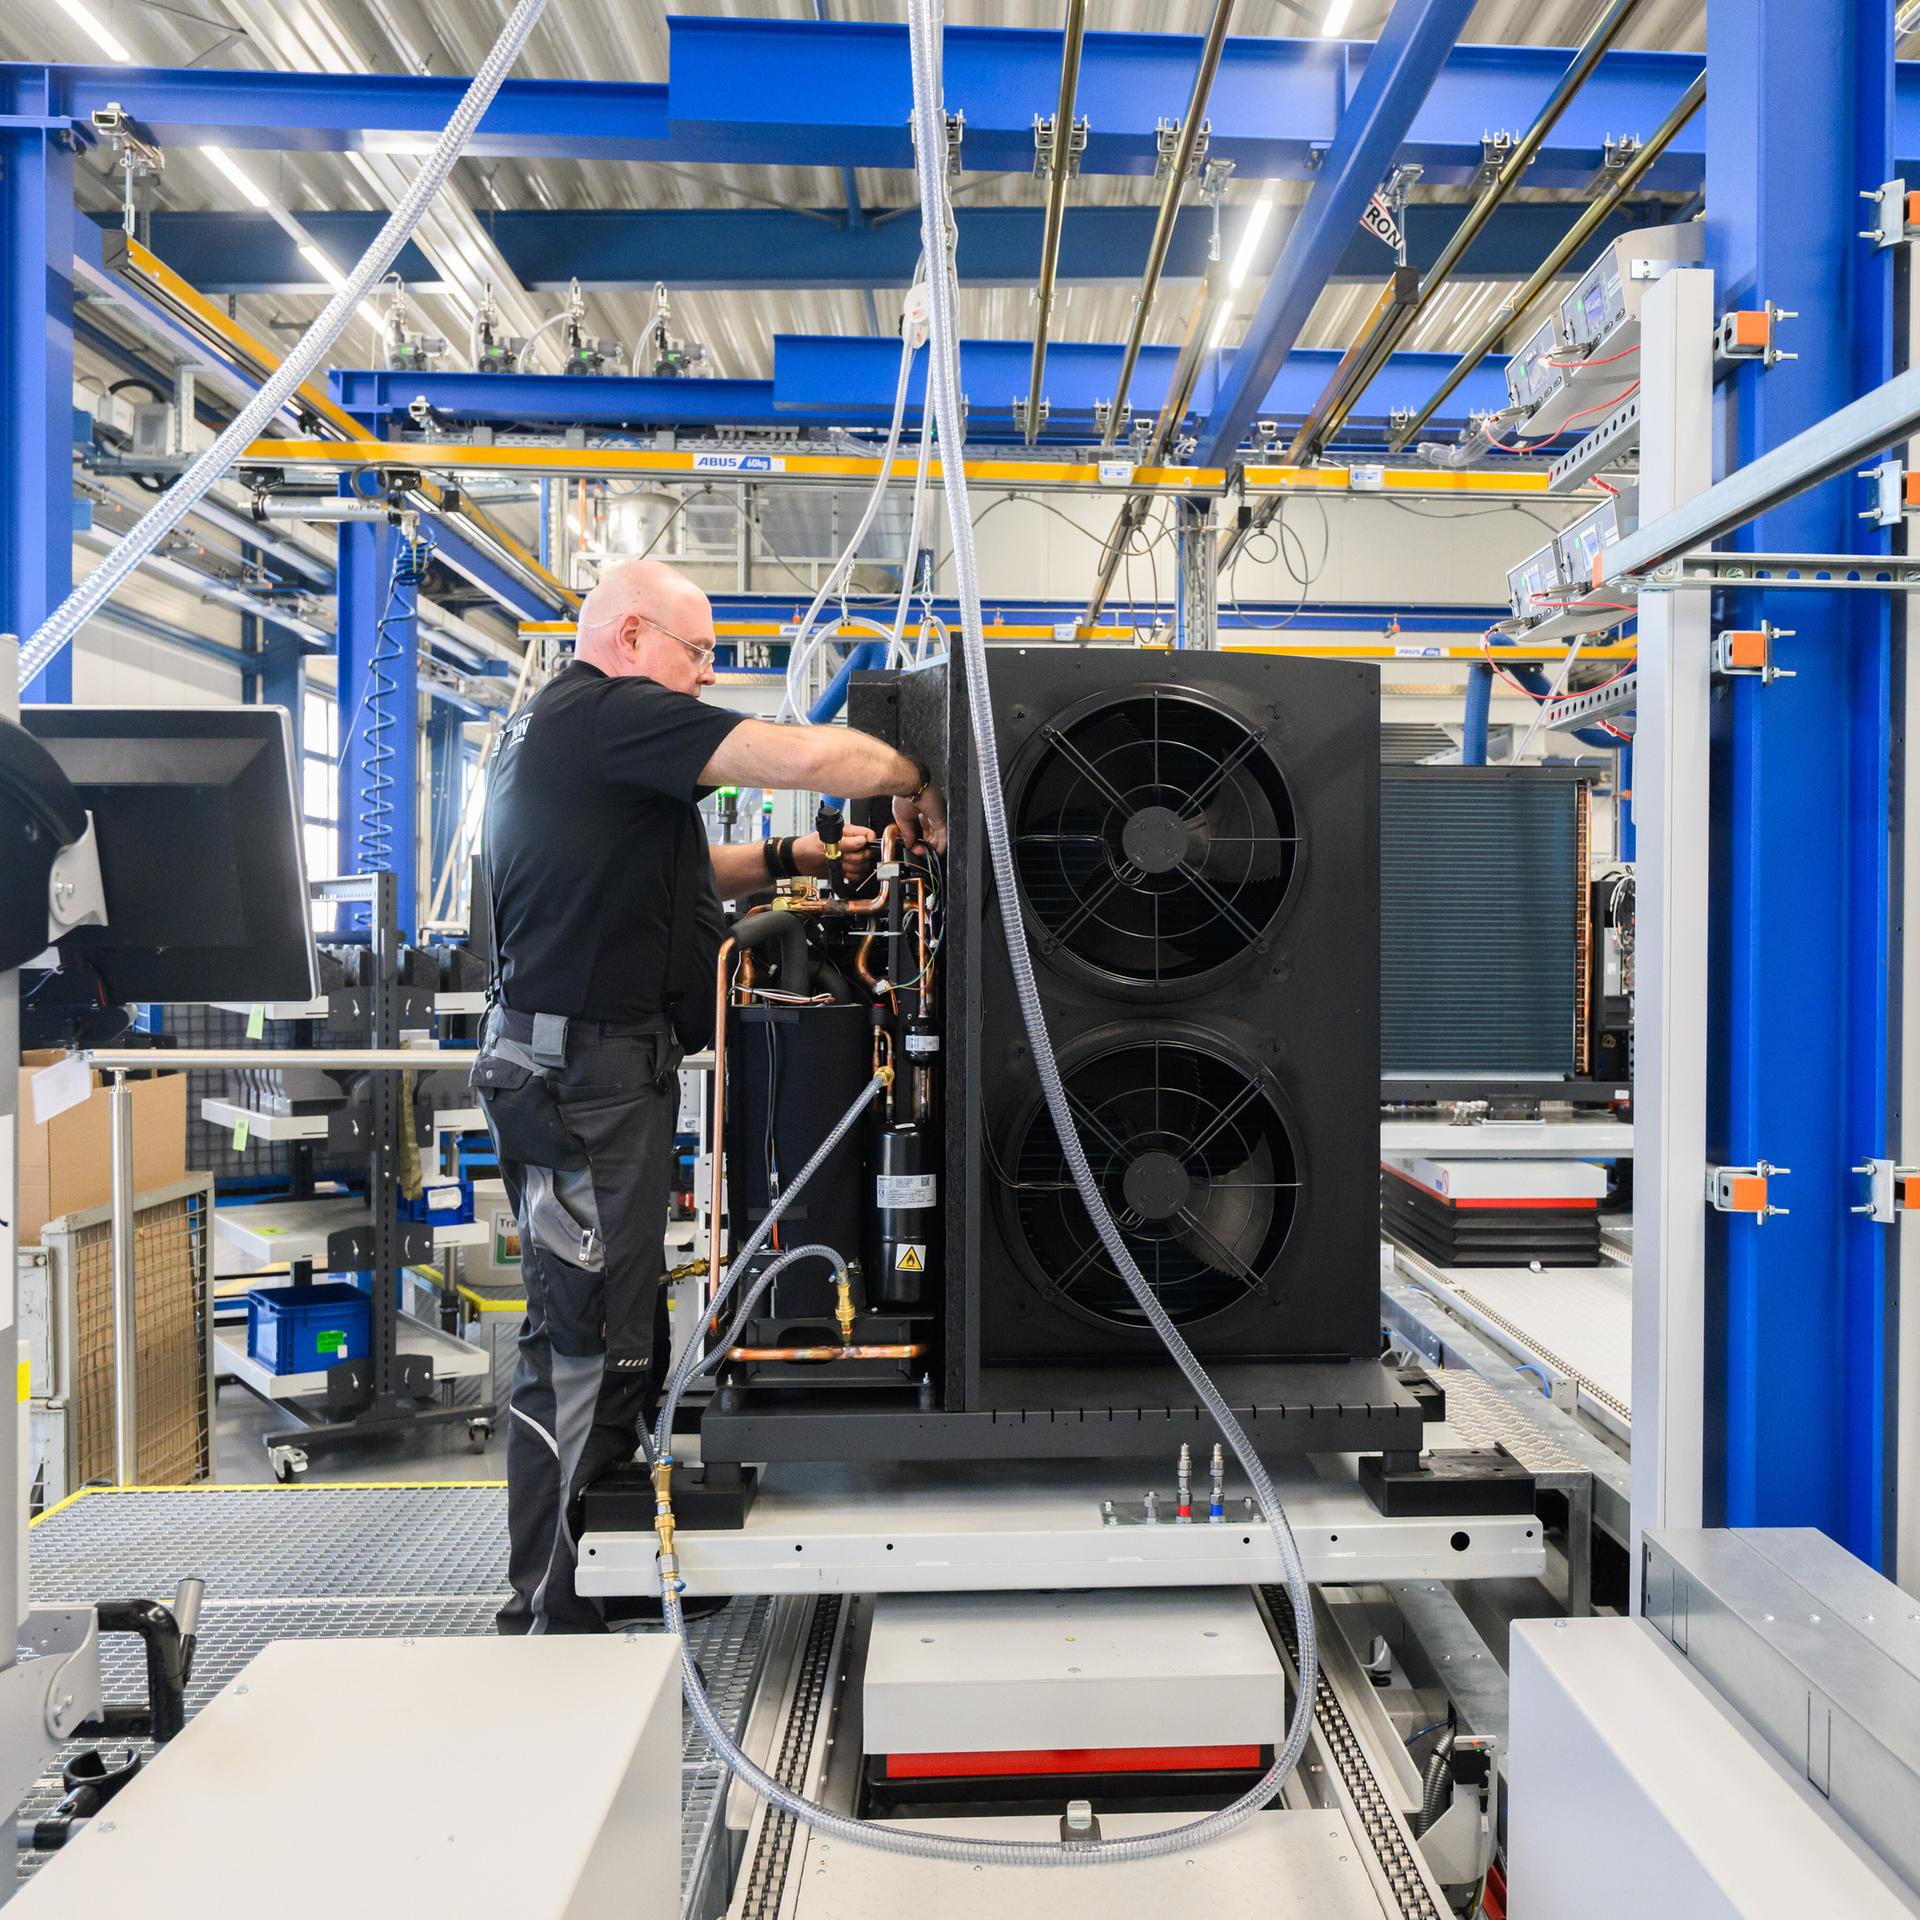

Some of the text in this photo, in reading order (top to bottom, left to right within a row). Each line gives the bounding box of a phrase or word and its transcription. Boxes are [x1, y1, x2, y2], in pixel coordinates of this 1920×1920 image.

[1366, 202, 1402, 247] RON
[697, 457, 737, 467] ABUS
[746, 458, 768, 469] 60kg
[499, 1219, 518, 1230] Tra
